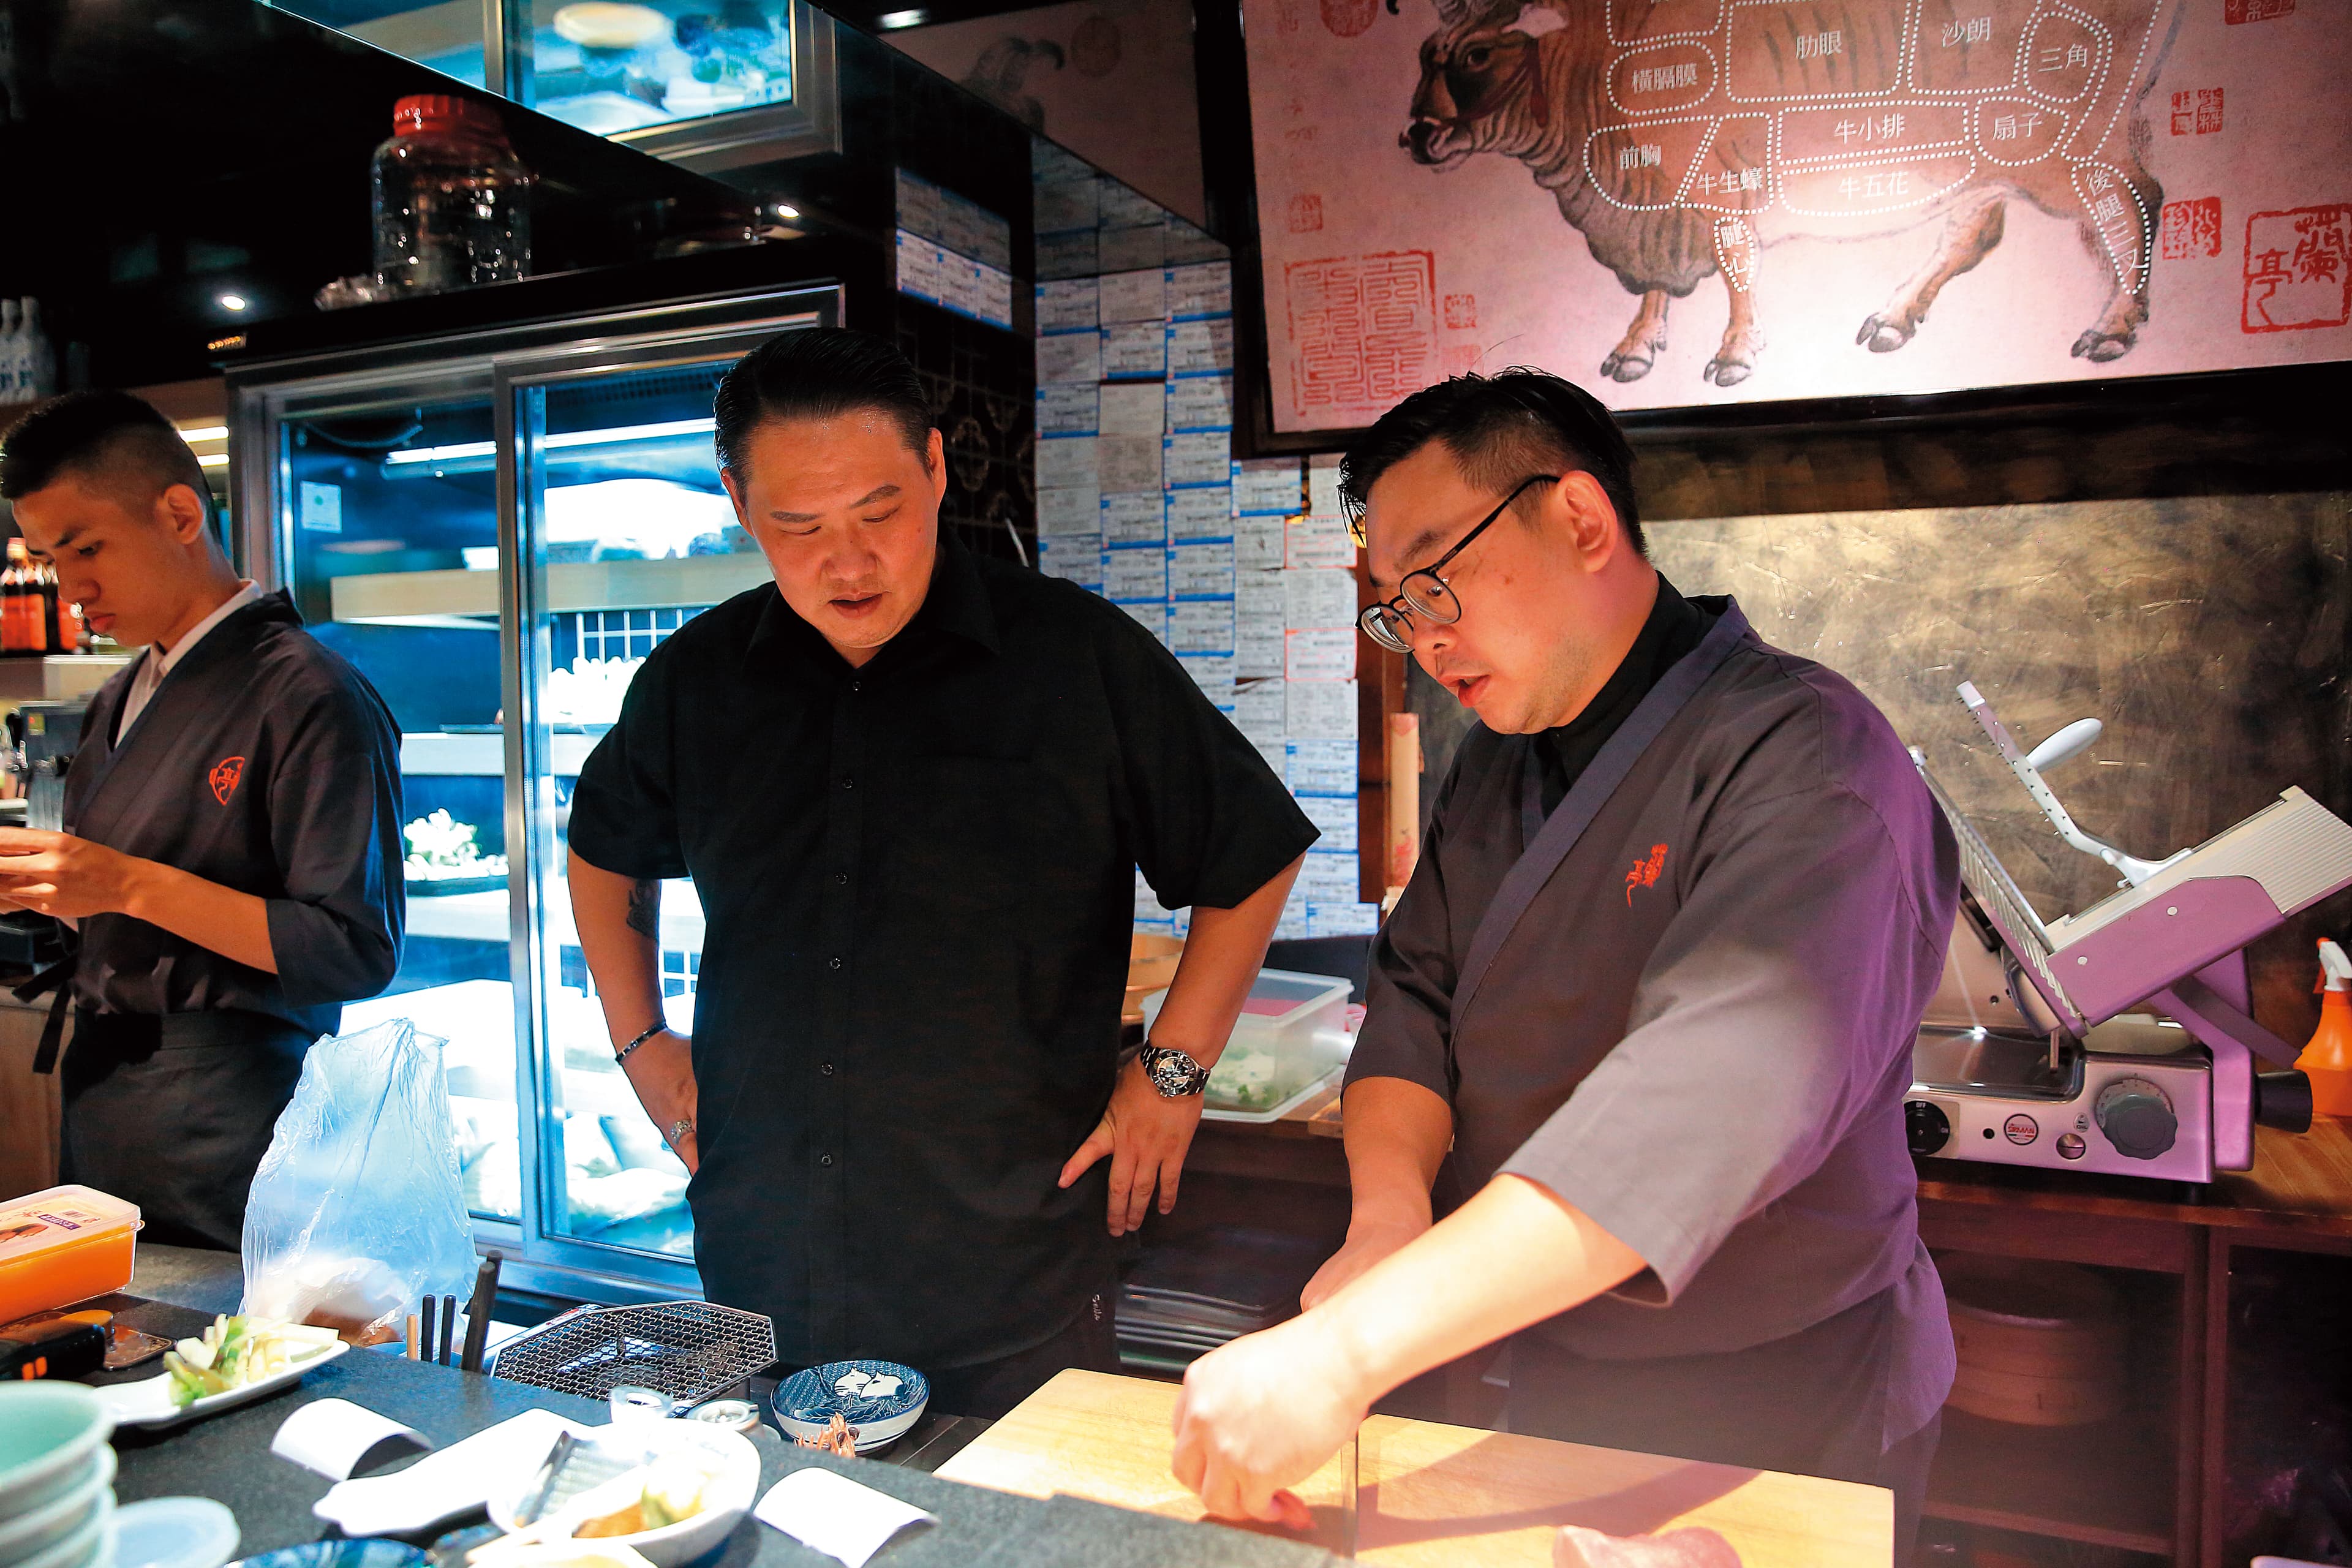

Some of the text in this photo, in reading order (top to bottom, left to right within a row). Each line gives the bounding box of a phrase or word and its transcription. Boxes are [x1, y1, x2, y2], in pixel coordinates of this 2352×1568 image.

[1795, 30, 1842, 60] 肋眼
[1942, 17, 1991, 47] 沙朗
[2038, 43, 2087, 72] 三角
[1833, 113, 1905, 144] 牛小排
[1992, 111, 2043, 140] 扇子
[1619, 143, 1662, 170] 前胸
[1696, 167, 1763, 196] 牛生蠔
[1838, 171, 1909, 200] 牛五花
[2086, 169, 2149, 277] 後腿三叉
